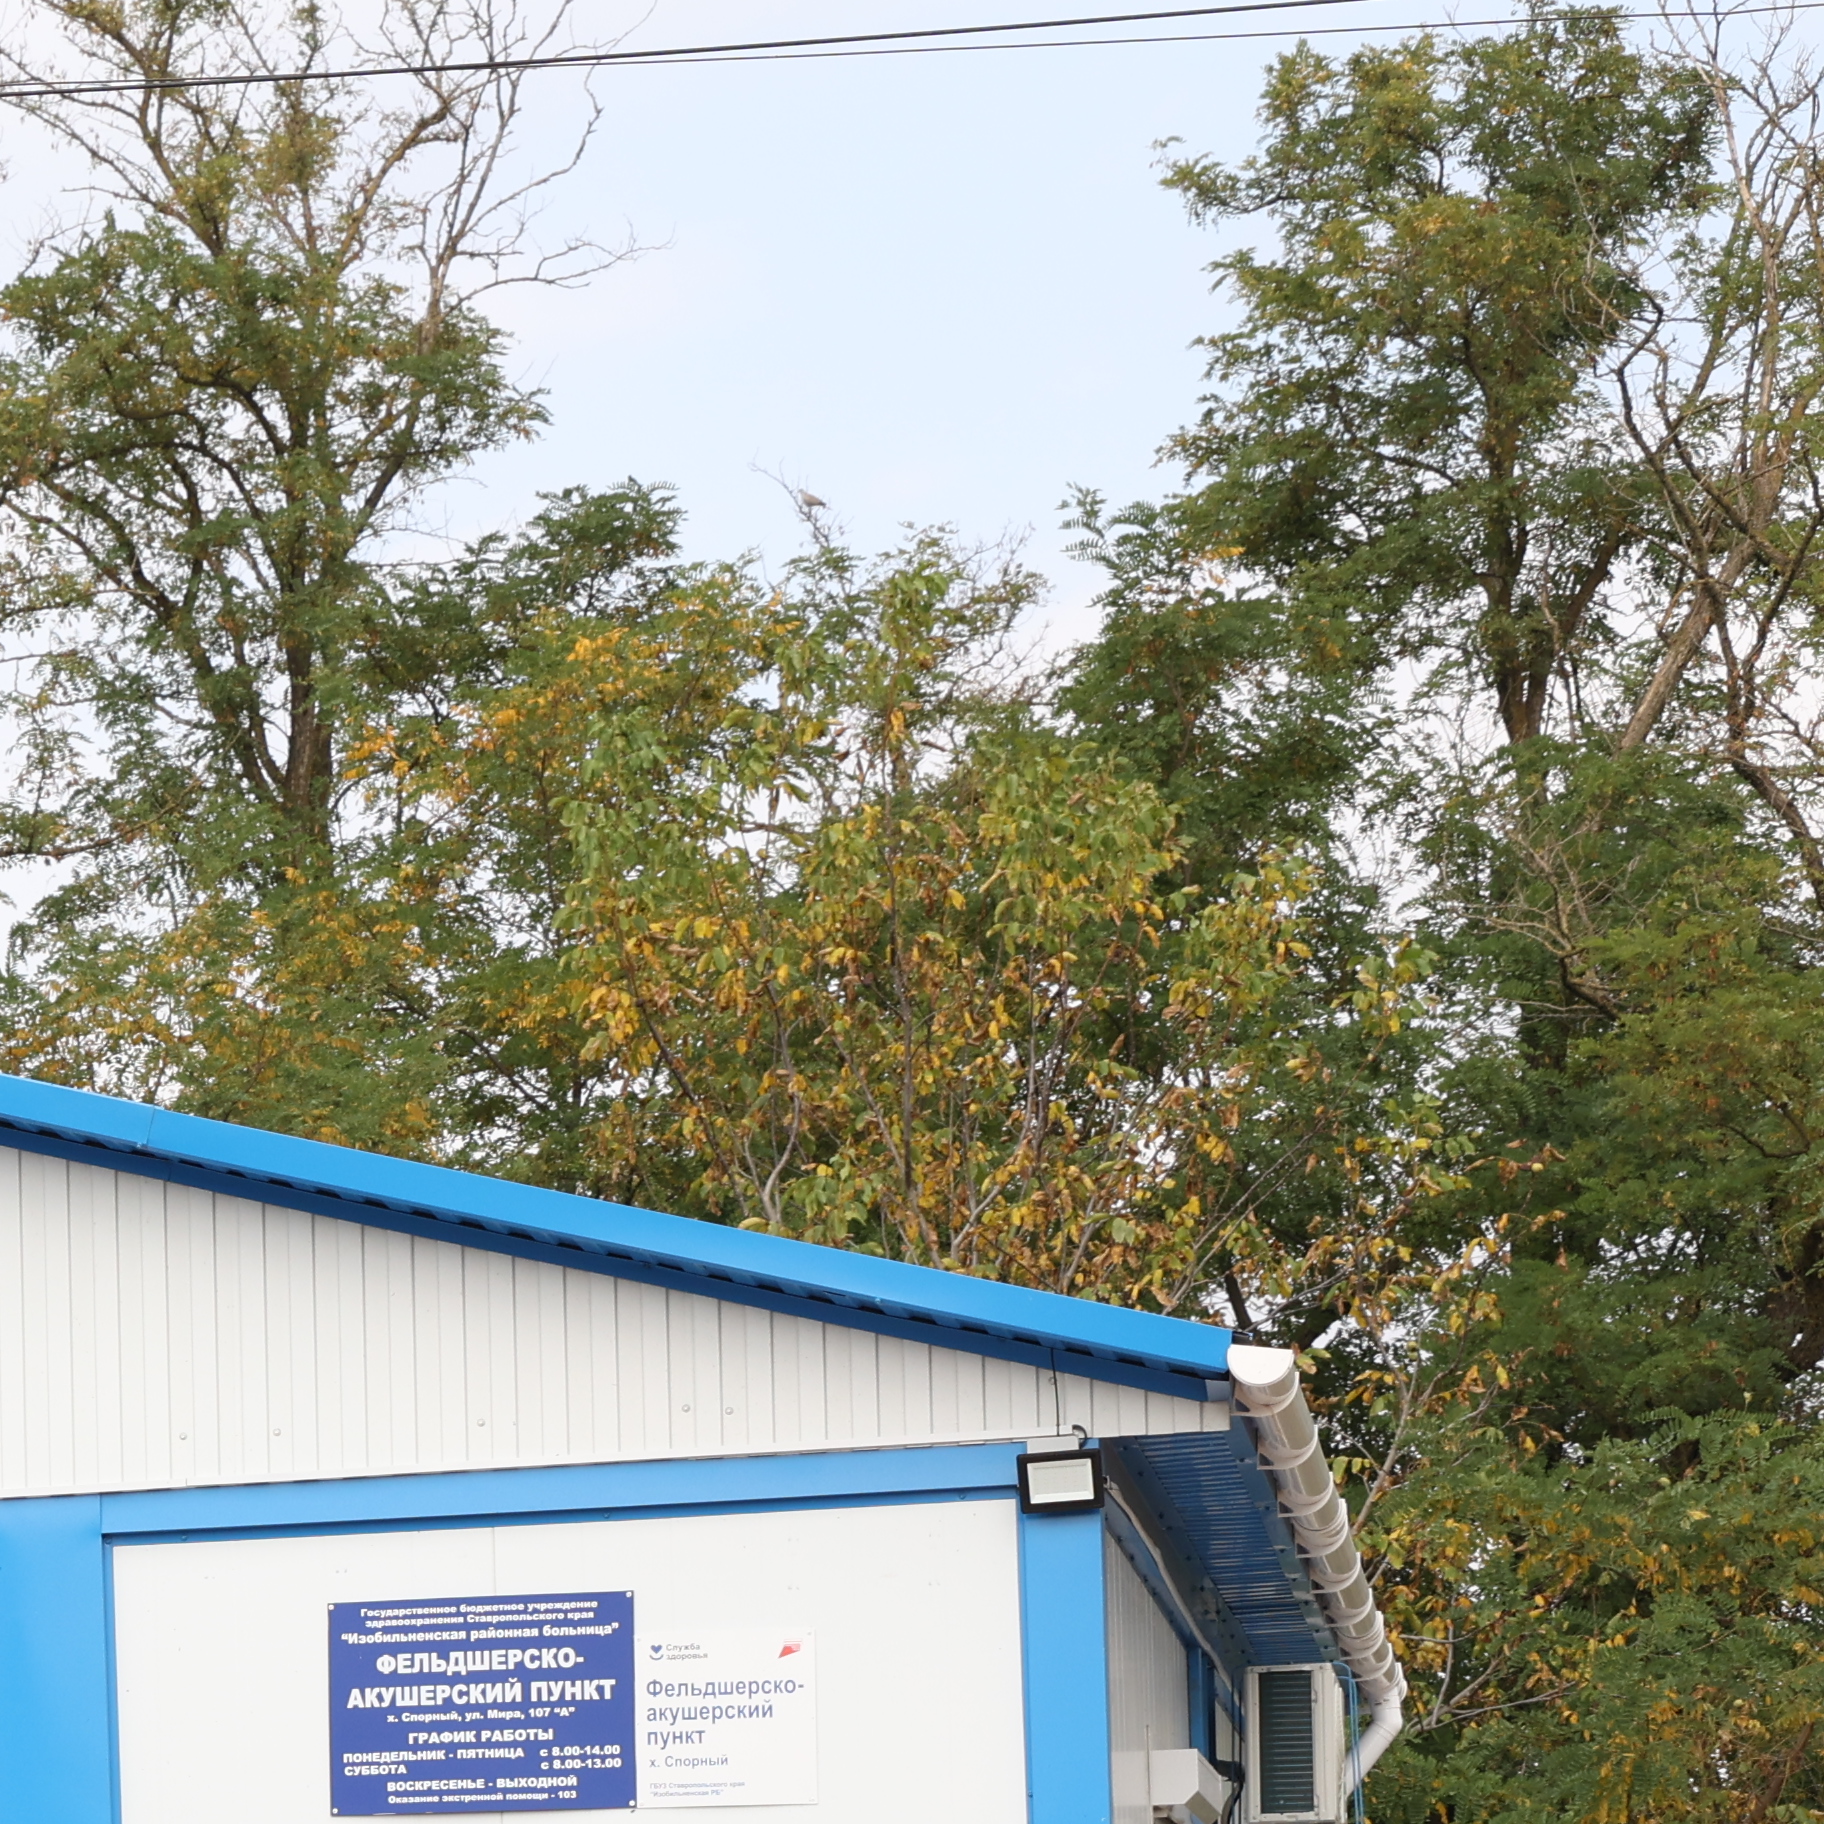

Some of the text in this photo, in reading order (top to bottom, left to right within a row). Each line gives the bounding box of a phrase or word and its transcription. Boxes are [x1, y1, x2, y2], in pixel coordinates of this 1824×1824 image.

[360, 1601, 598, 1618] Государственное бюджетное учреждение
[365, 1611, 594, 1628] здравоохранения Ставропольского края
[470, 1627, 539, 1641] районная
[665, 1643, 701, 1652] Служба
[376, 1647, 584, 1676] ФЕЛЬДШЕРСКО-
[666, 1653, 709, 1661] здоровья
[346, 1677, 616, 1709] АКУШЕРСКИЙ ПУНКТ
[645, 1678, 805, 1699] Фельдшерско-
[401, 1711, 462, 1723] Спорный,
[464, 1710, 484, 1722] ул.
[487, 1709, 525, 1720] Мира,
[528, 1707, 551, 1717] 107
[646, 1699, 774, 1726] акушерский
[408, 1728, 554, 1744] ГРАФИК РАБОТЫ
[646, 1729, 706, 1751] пункт
[343, 1750, 446, 1763] ПОНЕДЕЛЬНИК
[456, 1747, 525, 1760] ПЯТНИЦА
[551, 1744, 621, 1757] 8.00-14.00
[664, 1753, 729, 1770] Спорный
[344, 1764, 407, 1776] СУББОТА
[552, 1758, 622, 1770] 8.00-13.00
[386, 1778, 486, 1792] ВОСКРЕСЕНЬЕ
[496, 1775, 577, 1788] ВЫХОДНОЙ
[387, 1794, 440, 1804] Оказание
[441, 1792, 504, 1803] экстренной
[505, 1792, 549, 1800] помощи
[557, 1790, 577, 1799] 103
